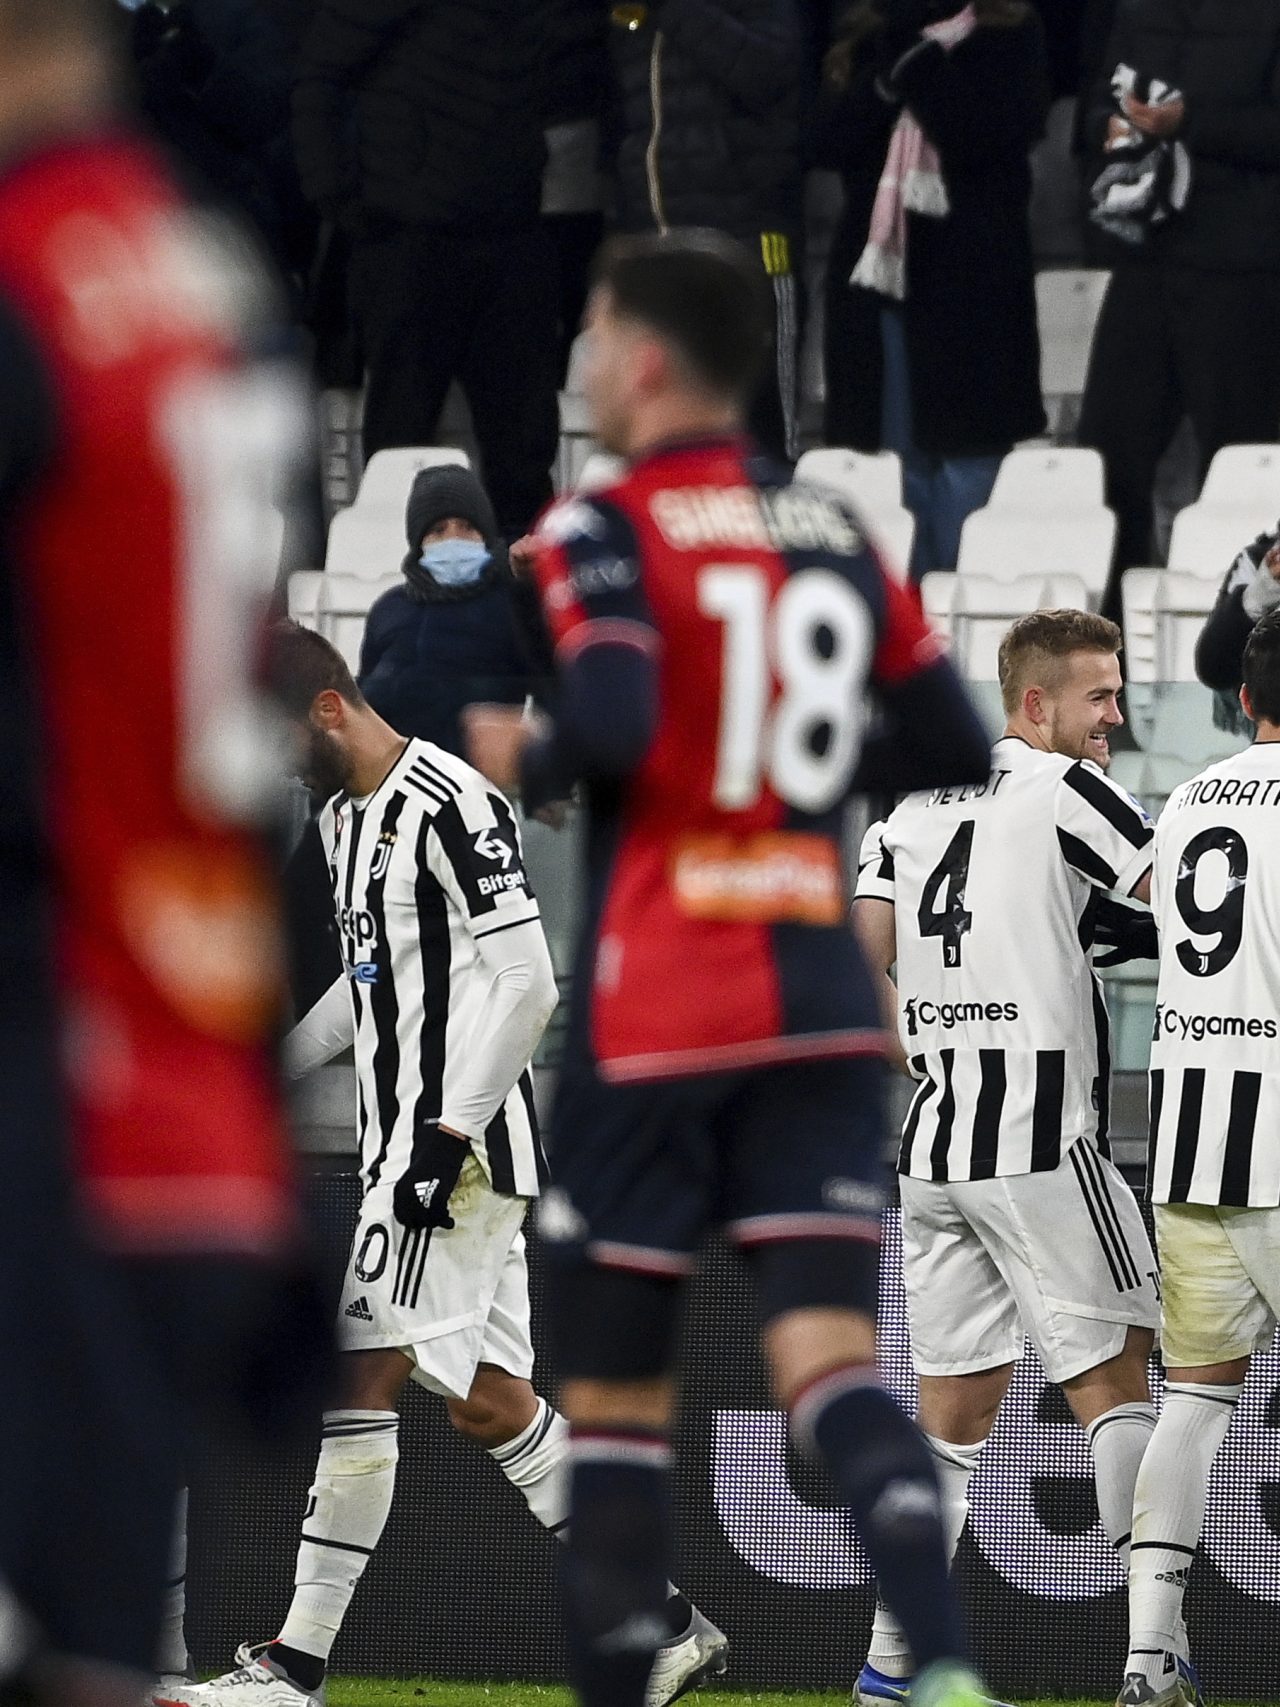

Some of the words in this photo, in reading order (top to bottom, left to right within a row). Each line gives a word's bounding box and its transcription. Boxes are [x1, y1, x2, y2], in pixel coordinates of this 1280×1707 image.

[697, 563, 874, 813] 18
[477, 869, 526, 895] Bitget
[917, 820, 975, 968] 4
[1175, 826, 1249, 977] 9
[1164, 1009, 1277, 1041] Cygames
[354, 1223, 389, 1283] 0
